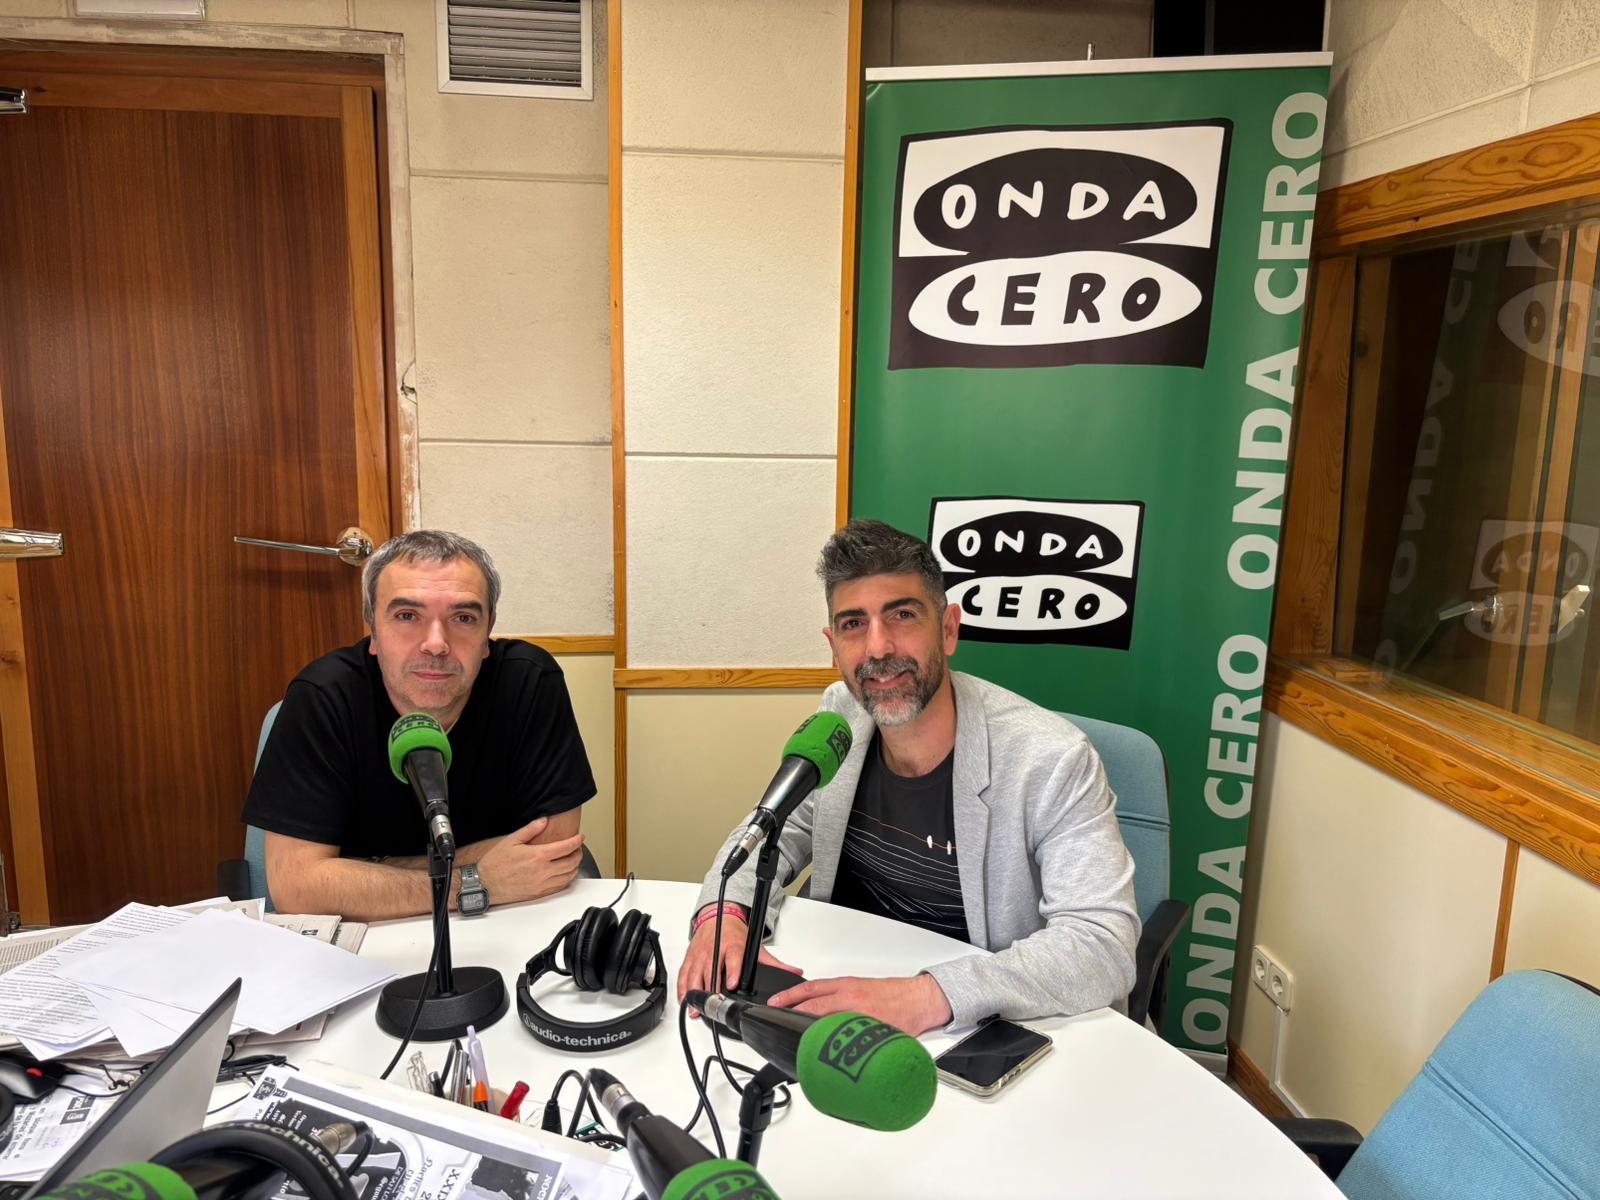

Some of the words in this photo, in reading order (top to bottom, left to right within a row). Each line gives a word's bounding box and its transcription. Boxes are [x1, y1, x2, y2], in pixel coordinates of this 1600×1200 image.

[941, 180, 1167, 230] ONDA
[1253, 91, 1328, 318] CERO
[946, 272, 1162, 326] CERO
[1225, 345, 1300, 591] ONDA
[957, 528, 1104, 560] ONDA
[961, 584, 1103, 621] CERO
[1203, 634, 1269, 820] CERO
[1181, 845, 1248, 1047] ONDA
[529, 1023, 627, 1046] audio-technica
